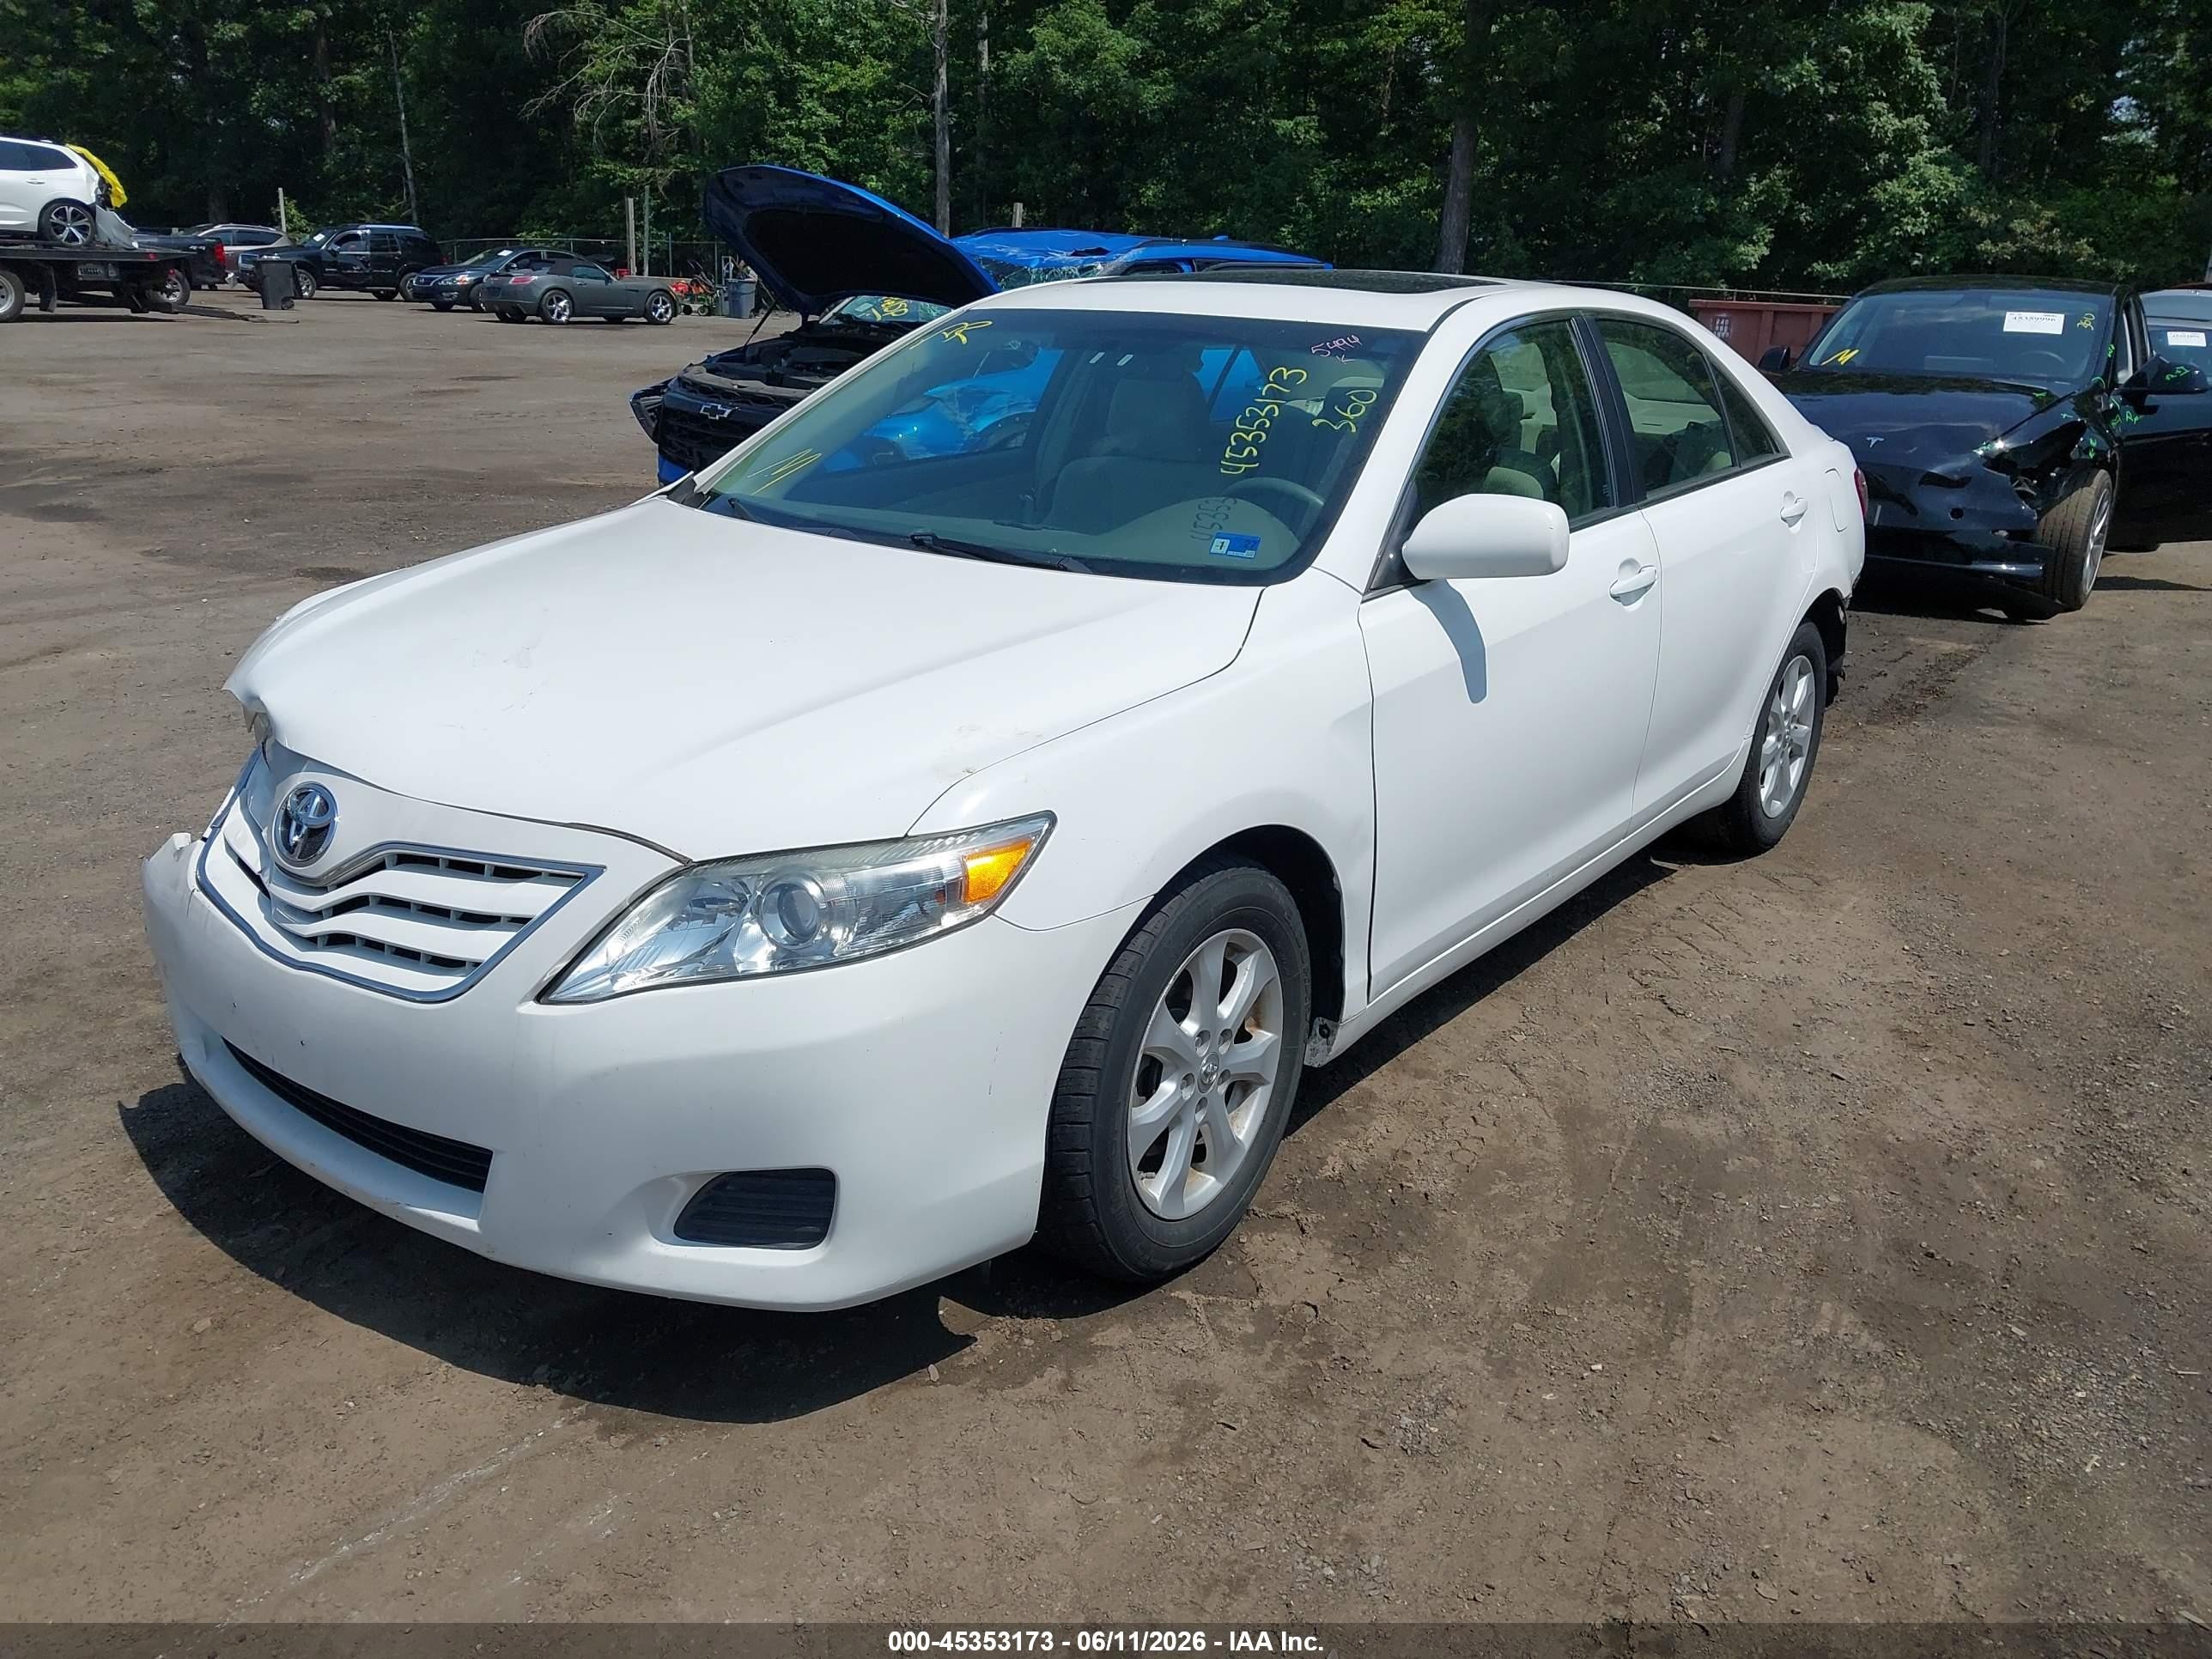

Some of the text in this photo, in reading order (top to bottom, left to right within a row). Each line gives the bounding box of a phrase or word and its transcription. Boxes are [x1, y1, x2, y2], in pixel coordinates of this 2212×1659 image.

[1310, 334, 1363, 357] 5494
[1220, 366, 1309, 475] 45353173
[1311, 389, 1378, 433] 360
